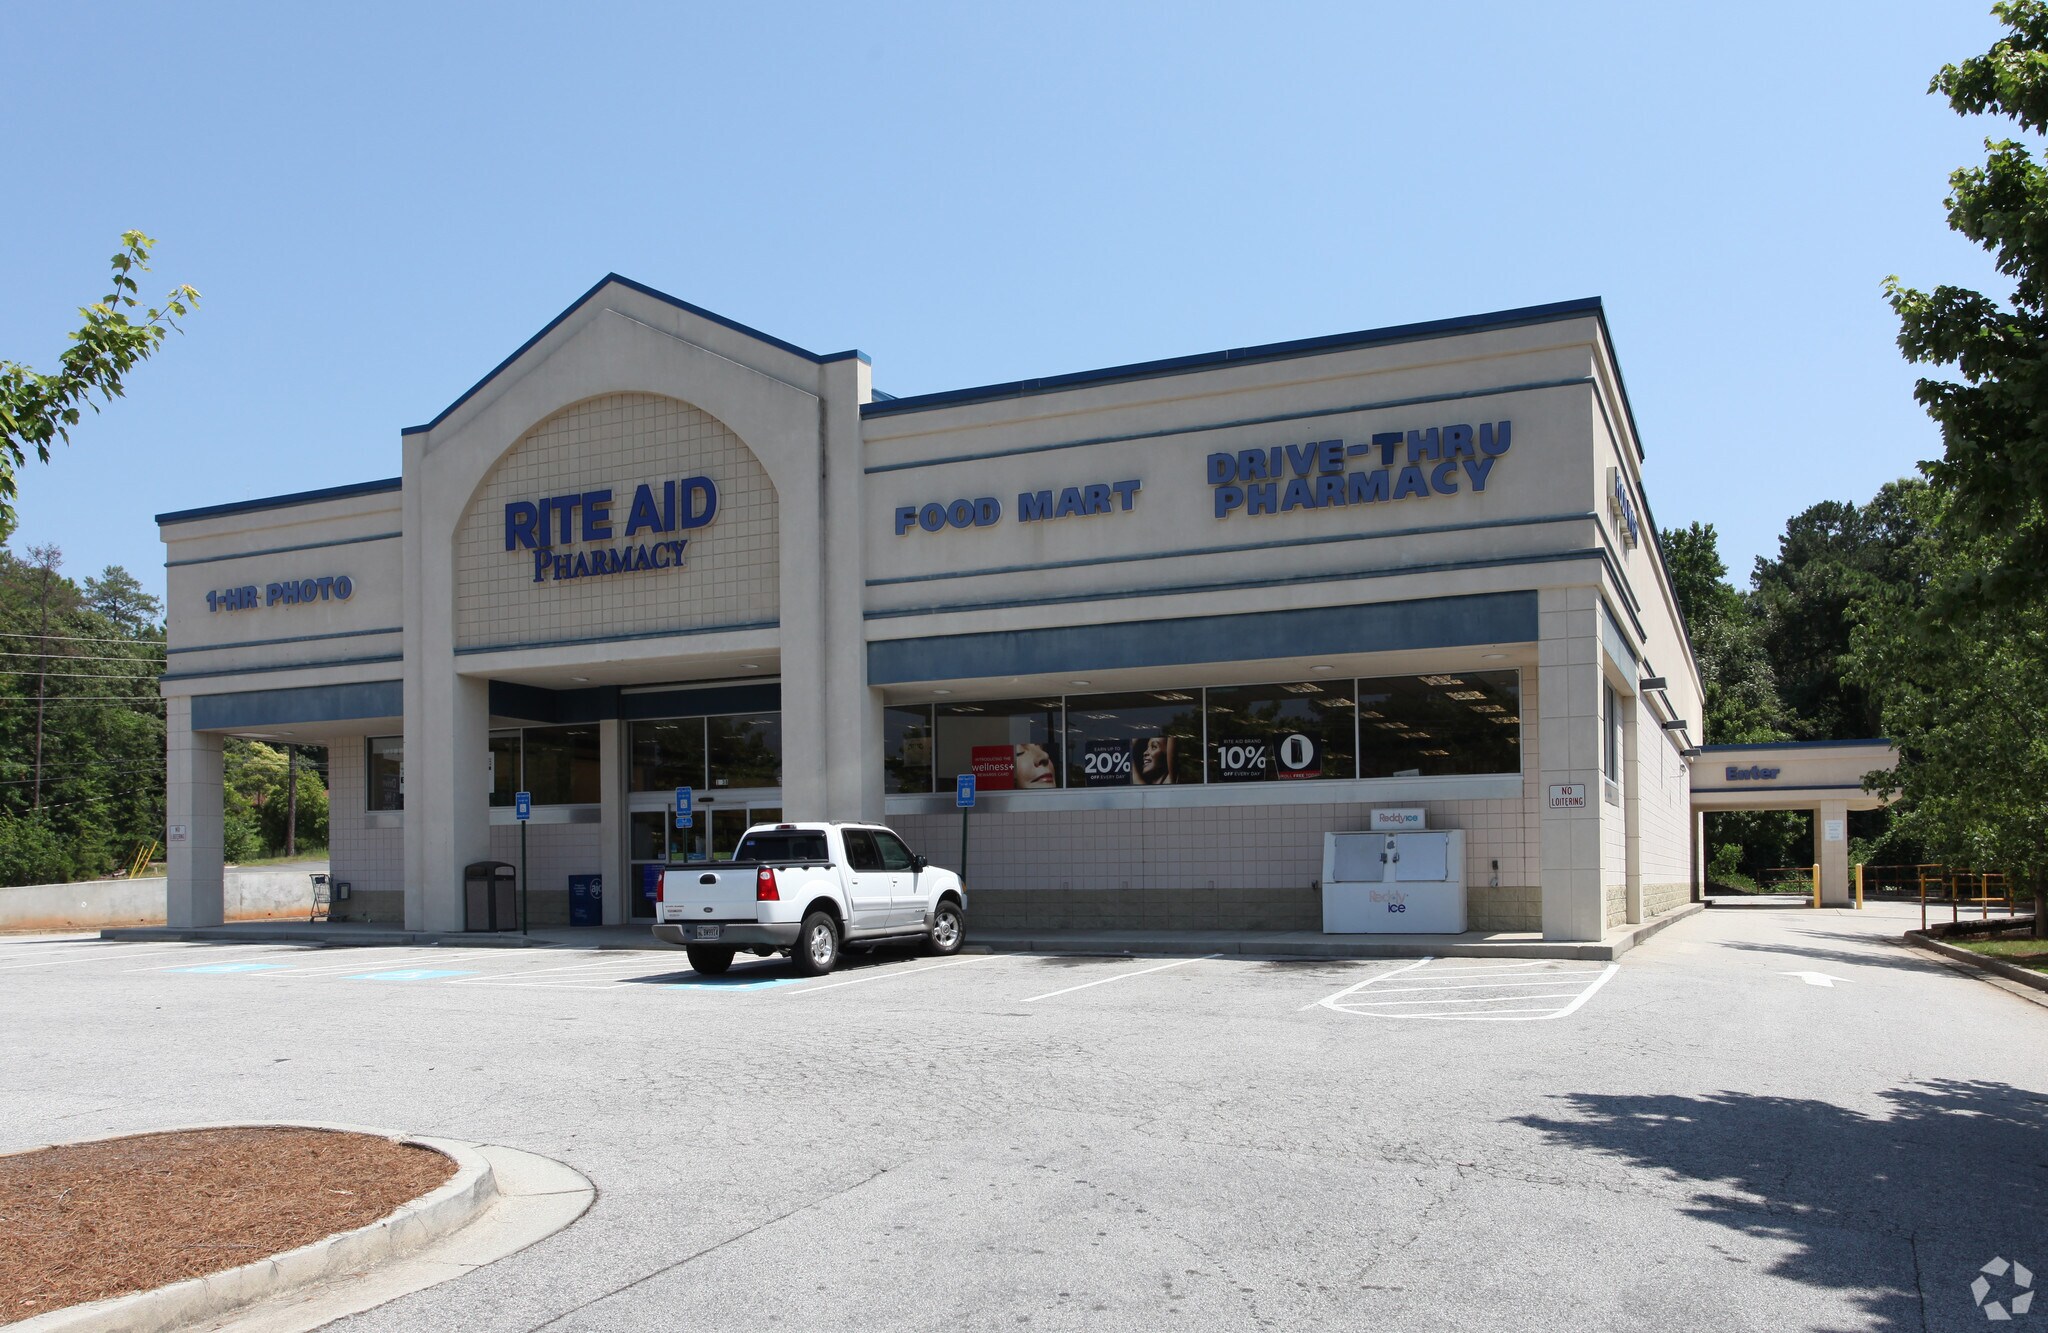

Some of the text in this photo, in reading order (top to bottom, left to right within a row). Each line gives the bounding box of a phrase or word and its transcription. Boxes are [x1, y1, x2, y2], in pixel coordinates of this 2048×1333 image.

[1207, 420, 1512, 485] DRIVE-THRU
[1214, 457, 1496, 519] PHARMACY
[505, 475, 719, 551] RITE AID
[895, 479, 1142, 535] FOOD MART
[533, 539, 688, 583] PHARMACY
[266, 575, 353, 607] PHOTO
[971, 762, 1015, 772] wellness+
[1084, 752, 1130, 774] 20%
[1217, 746, 1266, 769] 10%
[1725, 765, 1781, 781] Enter
[1551, 797, 1584, 806] LOITERING
[1561, 786, 1573, 795] NO
[1369, 888, 1407, 905] Reddy
[1387, 902, 1406, 913] ice
